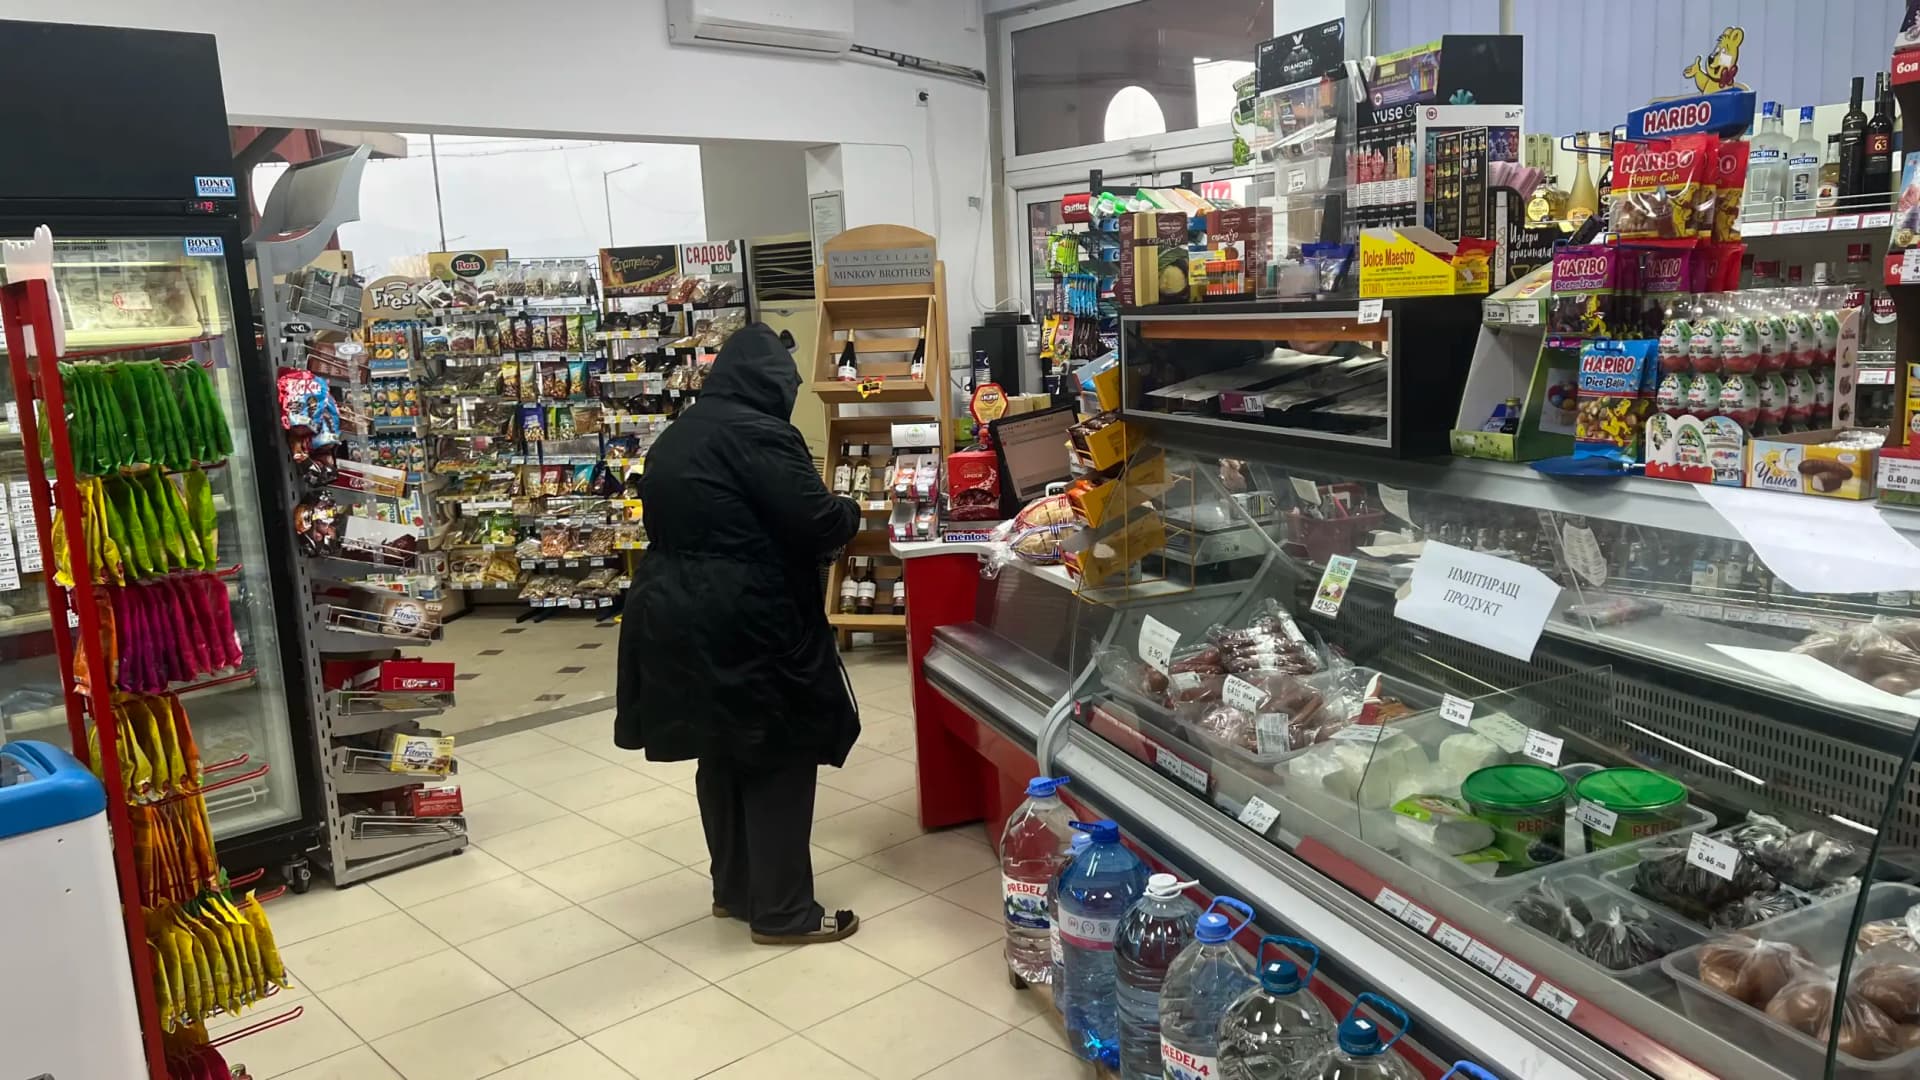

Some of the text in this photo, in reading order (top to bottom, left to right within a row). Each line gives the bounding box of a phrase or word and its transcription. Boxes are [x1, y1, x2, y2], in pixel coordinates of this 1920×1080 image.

[1283, 59, 1313, 72] DIAMOND
[1643, 101, 1711, 135] HARIBO
[1874, 139, 1888, 151] 63
[1620, 150, 1695, 173] HARIBO
[685, 244, 733, 265] САДОВО
[1363, 248, 1416, 268] Dolce Maestro
[834, 267, 931, 279] MINKOV BROTHERS
[1559, 258, 1607, 277] HARIBO
[1582, 356, 1635, 373] HARIBO
[1888, 475, 1908, 484] 0.80
[947, 533, 988, 541] mentos
[1447, 566, 1521, 600] ИМИТИРАЩ
[1443, 589, 1503, 617] ПРОДУКТ
[404, 746, 433, 758] Fitness
[1697, 851, 1715, 865] 0.46
